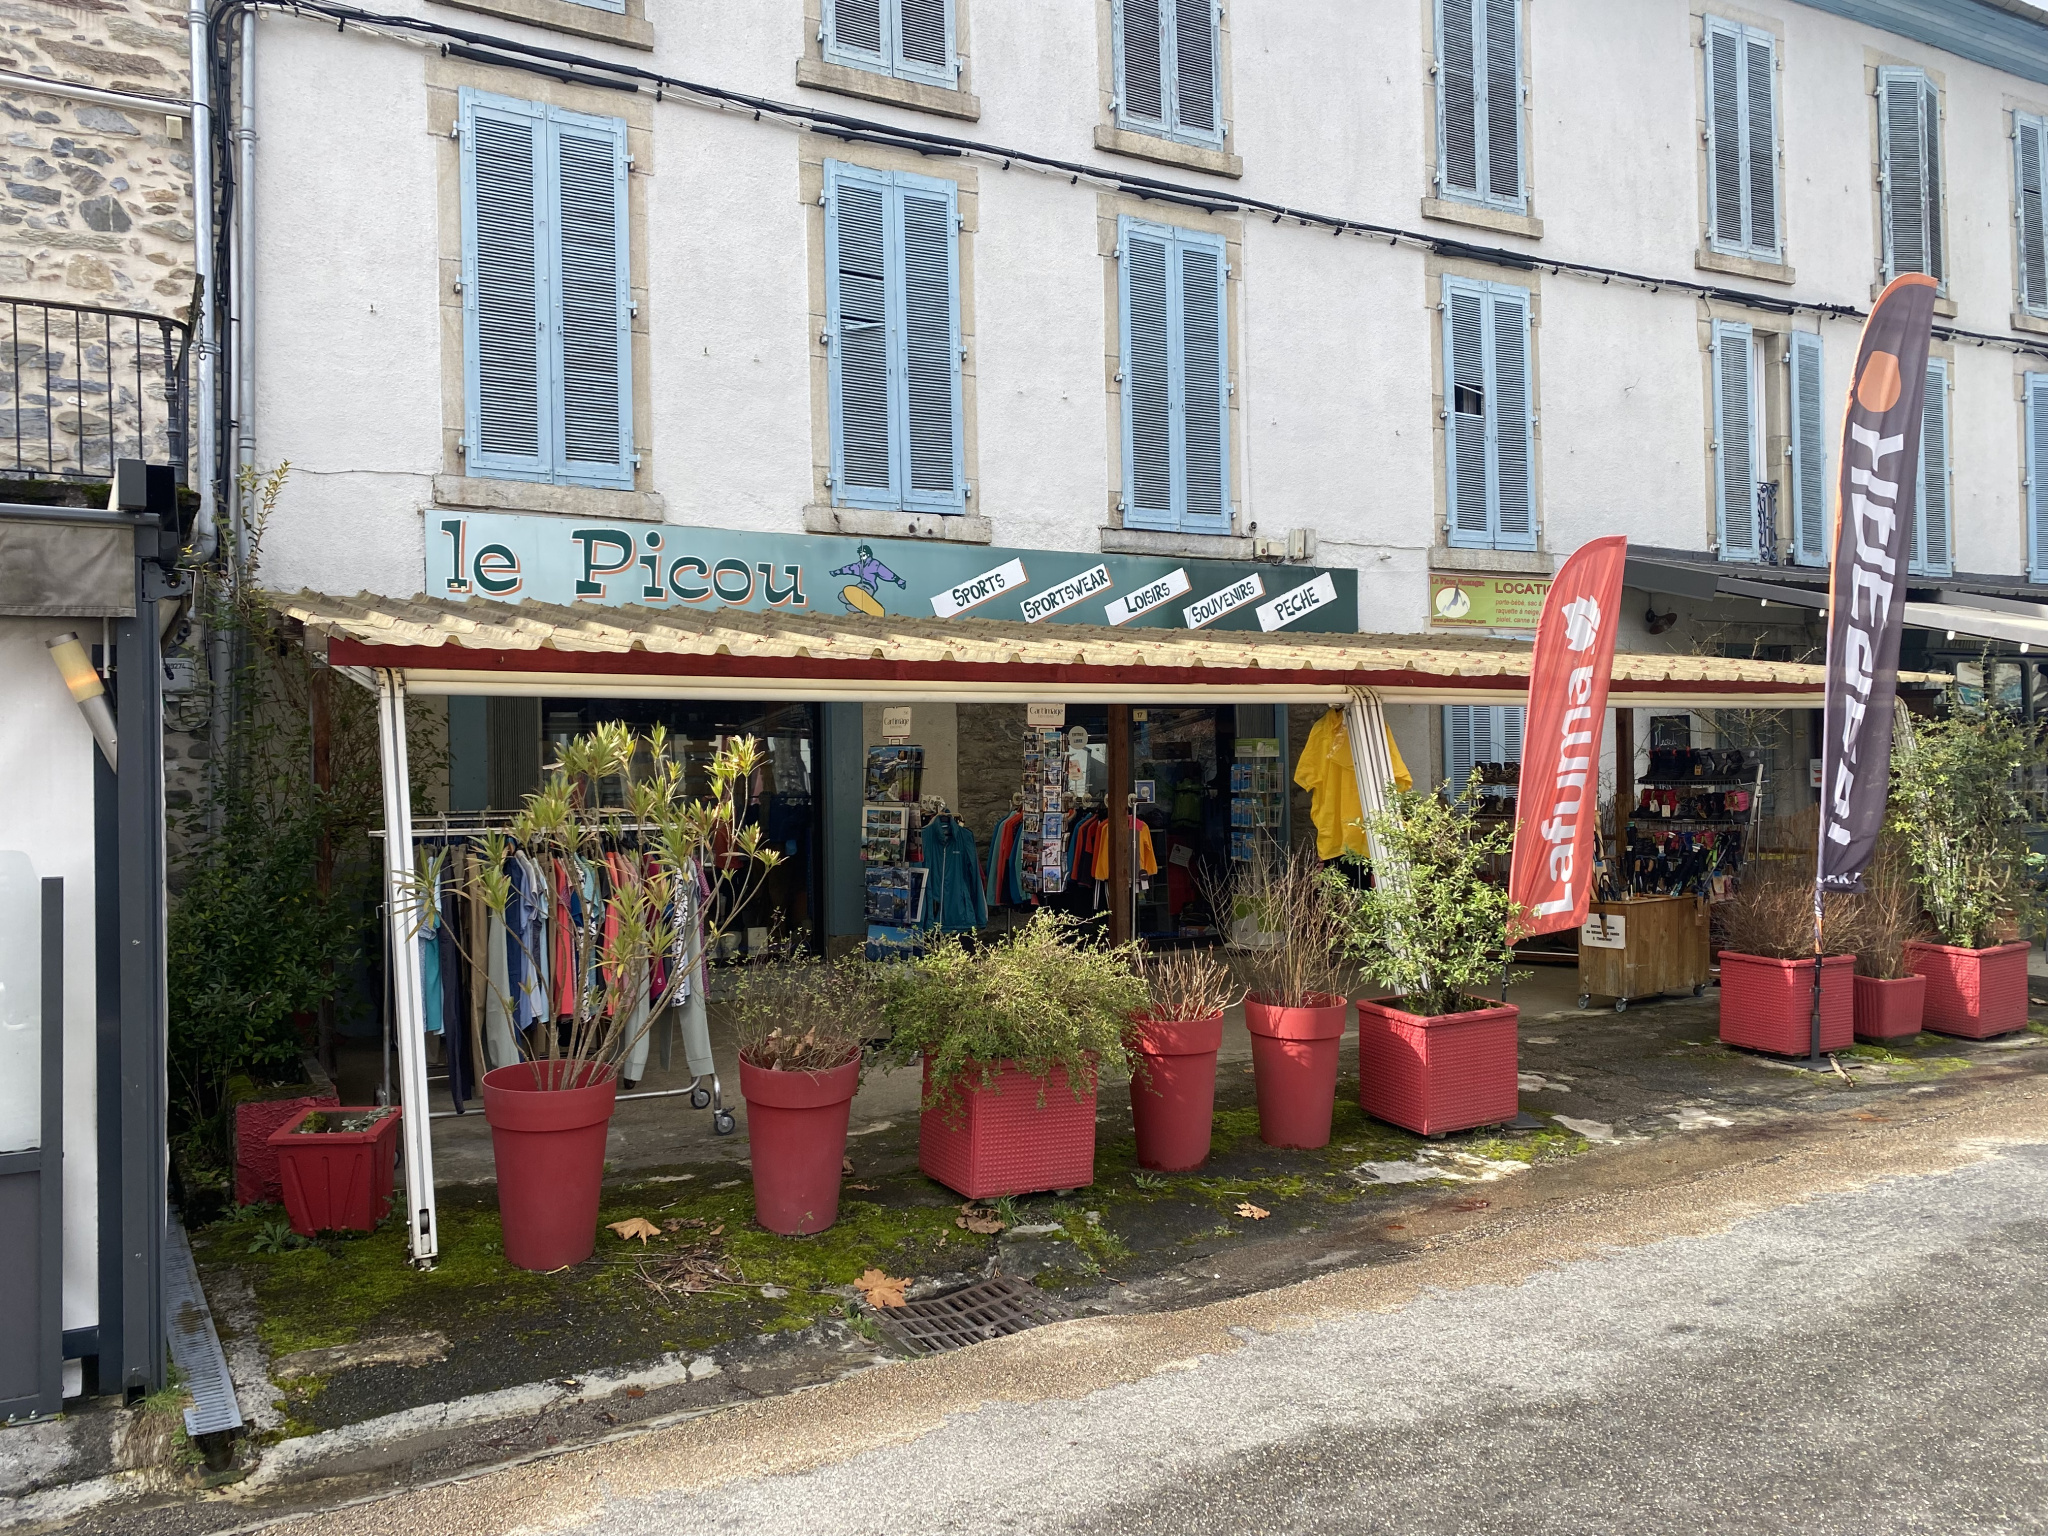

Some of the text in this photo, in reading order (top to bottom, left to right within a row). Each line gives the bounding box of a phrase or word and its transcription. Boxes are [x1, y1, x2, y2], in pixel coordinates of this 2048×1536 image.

[440, 518, 808, 608] le Picou
[952, 573, 1005, 608] SPORTS
[1023, 568, 1108, 620] SPORTSWEAR
[1123, 581, 1171, 614] LOISIRS
[1191, 580, 1255, 623] SOUVENIRS
[1275, 586, 1320, 621] PECHE
[1495, 608, 1518, 616] raquette
[1533, 665, 1594, 917] Lafuma
